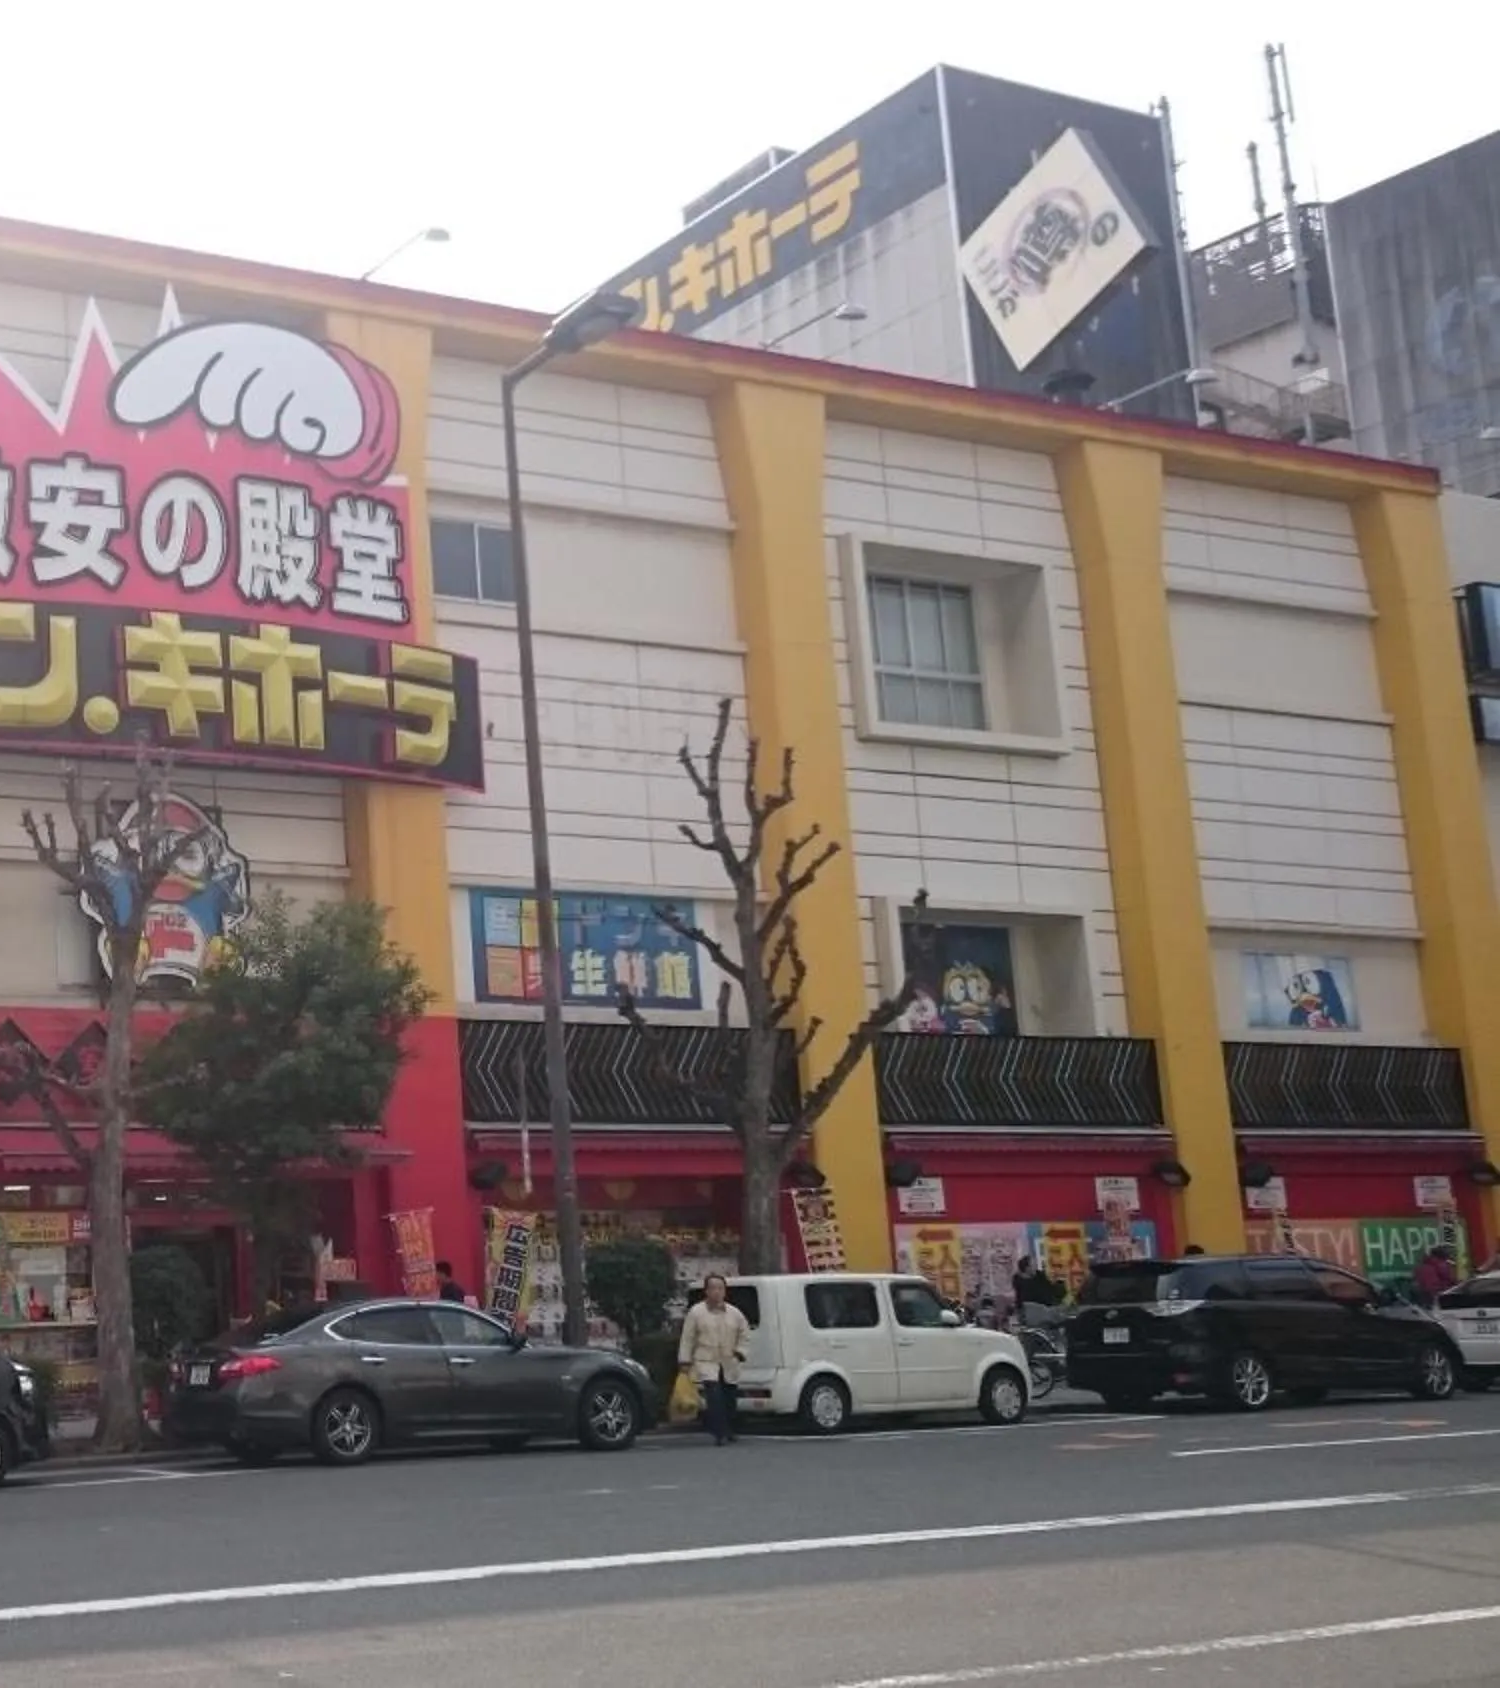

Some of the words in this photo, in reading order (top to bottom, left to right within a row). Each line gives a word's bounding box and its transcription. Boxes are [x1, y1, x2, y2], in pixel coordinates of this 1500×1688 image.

[571, 948, 694, 999] 生鮮館
[1247, 1227, 1357, 1267] TSTY!
[1363, 1227, 1442, 1267] HAPP
